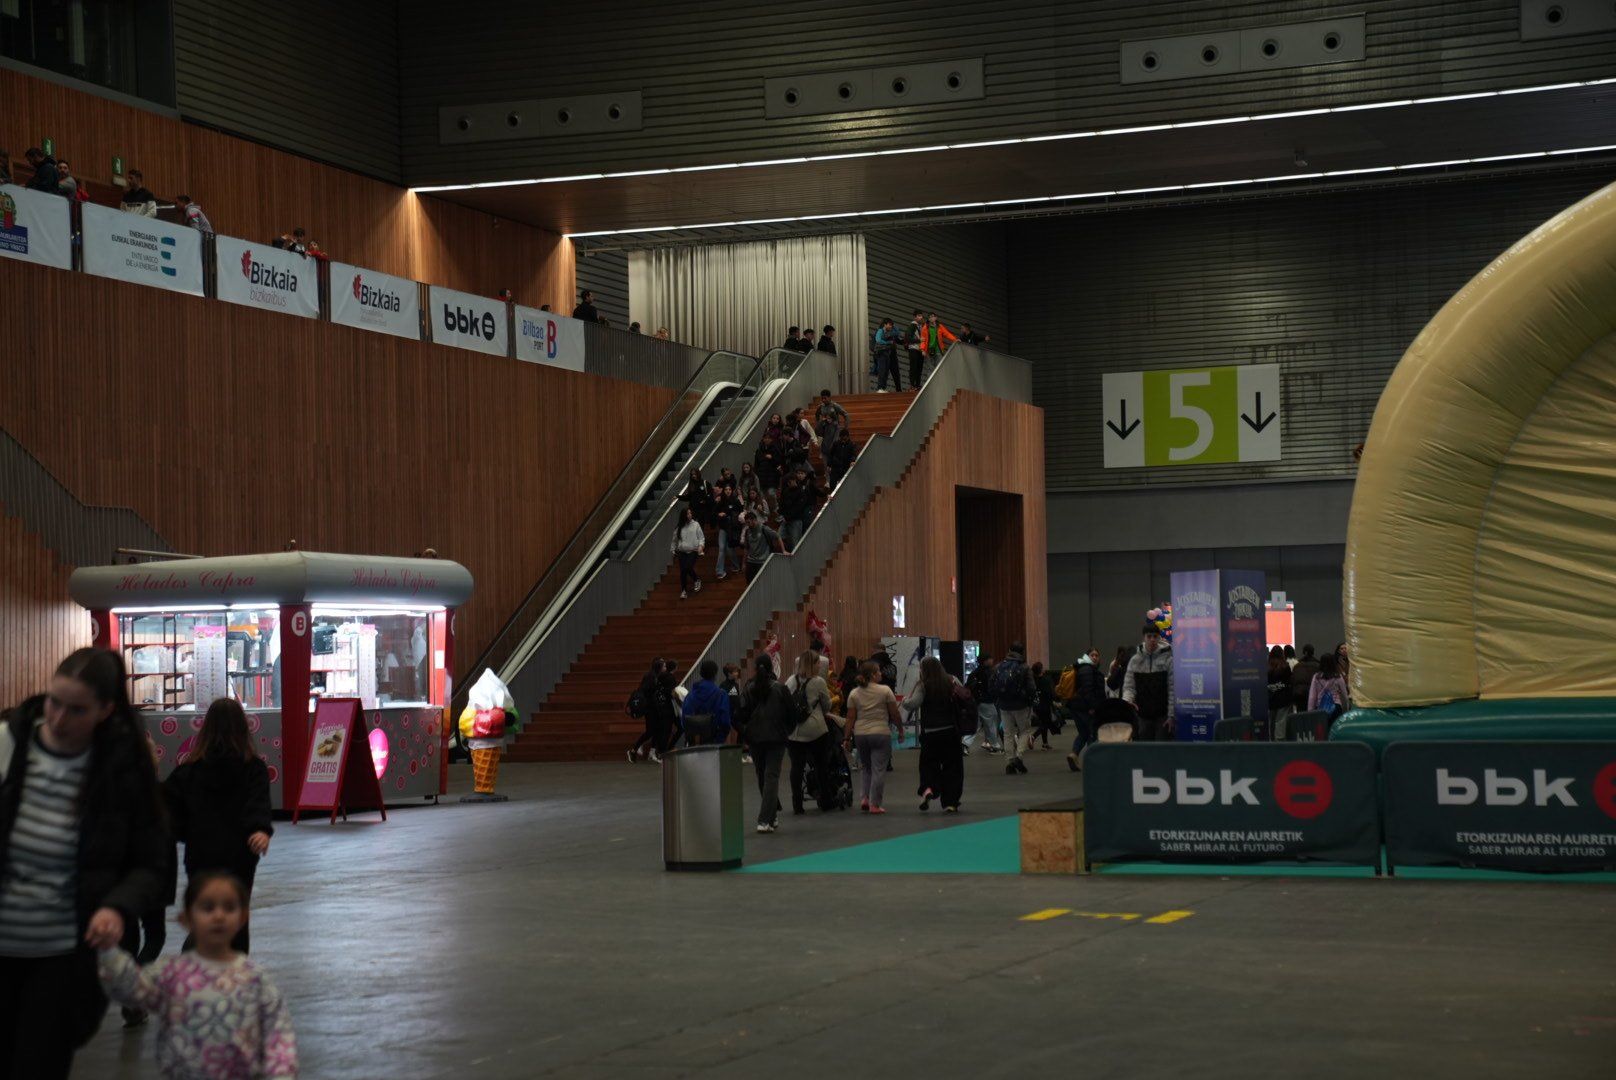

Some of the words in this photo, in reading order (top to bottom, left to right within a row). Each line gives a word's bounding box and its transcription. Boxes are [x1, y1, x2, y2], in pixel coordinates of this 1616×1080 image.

[251, 261, 297, 292] Bizkaia
[361, 284, 400, 312] Bizkaia
[444, 303, 480, 337] bbk
[523, 319, 544, 339] Bilbao
[533, 341, 544, 351] PORT
[1168, 371, 1214, 461] 5
[113, 572, 189, 592] Helados
[199, 570, 257, 594] Capra
[352, 567, 397, 588] Helados
[400, 567, 440, 596] Capra
[310, 762, 338, 774] GRATIS
[1132, 768, 1261, 805] bbk
[1436, 768, 1579, 807] bbk
[1149, 830, 1247, 842] ETORKIZUNAREN
[1247, 831, 1304, 843] AURRETIK
[1160, 842, 1192, 852] SABER
[1193, 842, 1226, 853] MIRAR
[1228, 843, 1241, 853] AL
[1243, 843, 1285, 853] FUTURO
[1456, 832, 1562, 845] ETORKIZUNAREN
[1468, 845, 1502, 855] SABER
[1505, 846, 1542, 856] MIRAR
[1543, 847, 1558, 856] AL
[1560, 847, 1607, 857] FUTURO
